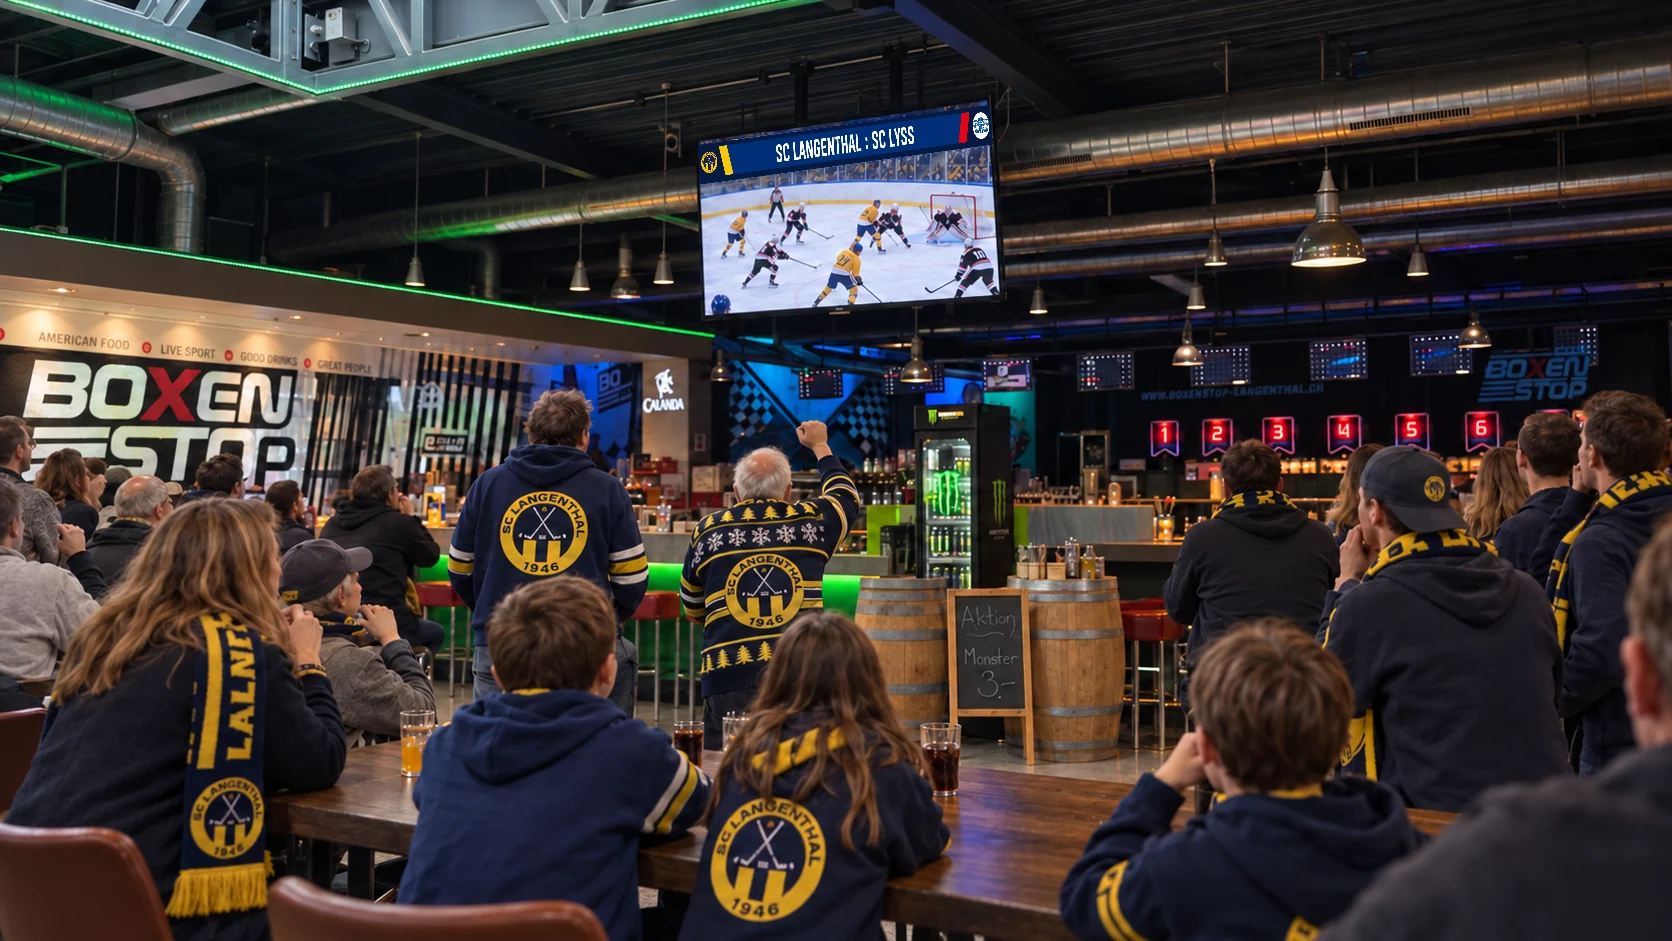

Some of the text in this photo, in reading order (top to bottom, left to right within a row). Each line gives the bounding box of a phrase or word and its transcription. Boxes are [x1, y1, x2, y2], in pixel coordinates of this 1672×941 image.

[776, 143, 791, 162] SC
[793, 134, 862, 160] LANGENTHAL
[871, 130, 886, 150] SC
[888, 125, 915, 147] LYSS
[38, 331, 130, 351] AMERICAN FOOD
[160, 344, 216, 359] LIVE SPORT
[240, 351, 298, 367] GOOD DRINKS
[317, 359, 372, 374] GREAT PEOPLE
[1484, 355, 1590, 379] BOXEN
[23, 359, 294, 424] BOXEN
[1514, 380, 1588, 401] STOP
[642, 397, 685, 413] CALANDA
[1161, 427, 1167, 443] 1
[1212, 426, 1223, 441] 2
[1273, 425, 1284, 439] 3
[1338, 423, 1350, 438] 4
[1406, 422, 1417, 437] 5
[1476, 420, 1487, 436] 6
[109, 426, 296, 488] STOP
[503, 493, 585, 538] SC LANGENTHAL
[523, 561, 559, 573] 1946
[727, 555, 802, 596] SC LANGENTHAL
[749, 614, 784, 627] 1946
[961, 605, 1016, 639] Aktion
[964, 647, 1019, 666] Monster
[202, 779, 262, 819] LANGENTHAL
[717, 800, 821, 867] SC LANGENTHAL
[214, 842, 244, 857] 1946
[732, 898, 780, 917] 1946
